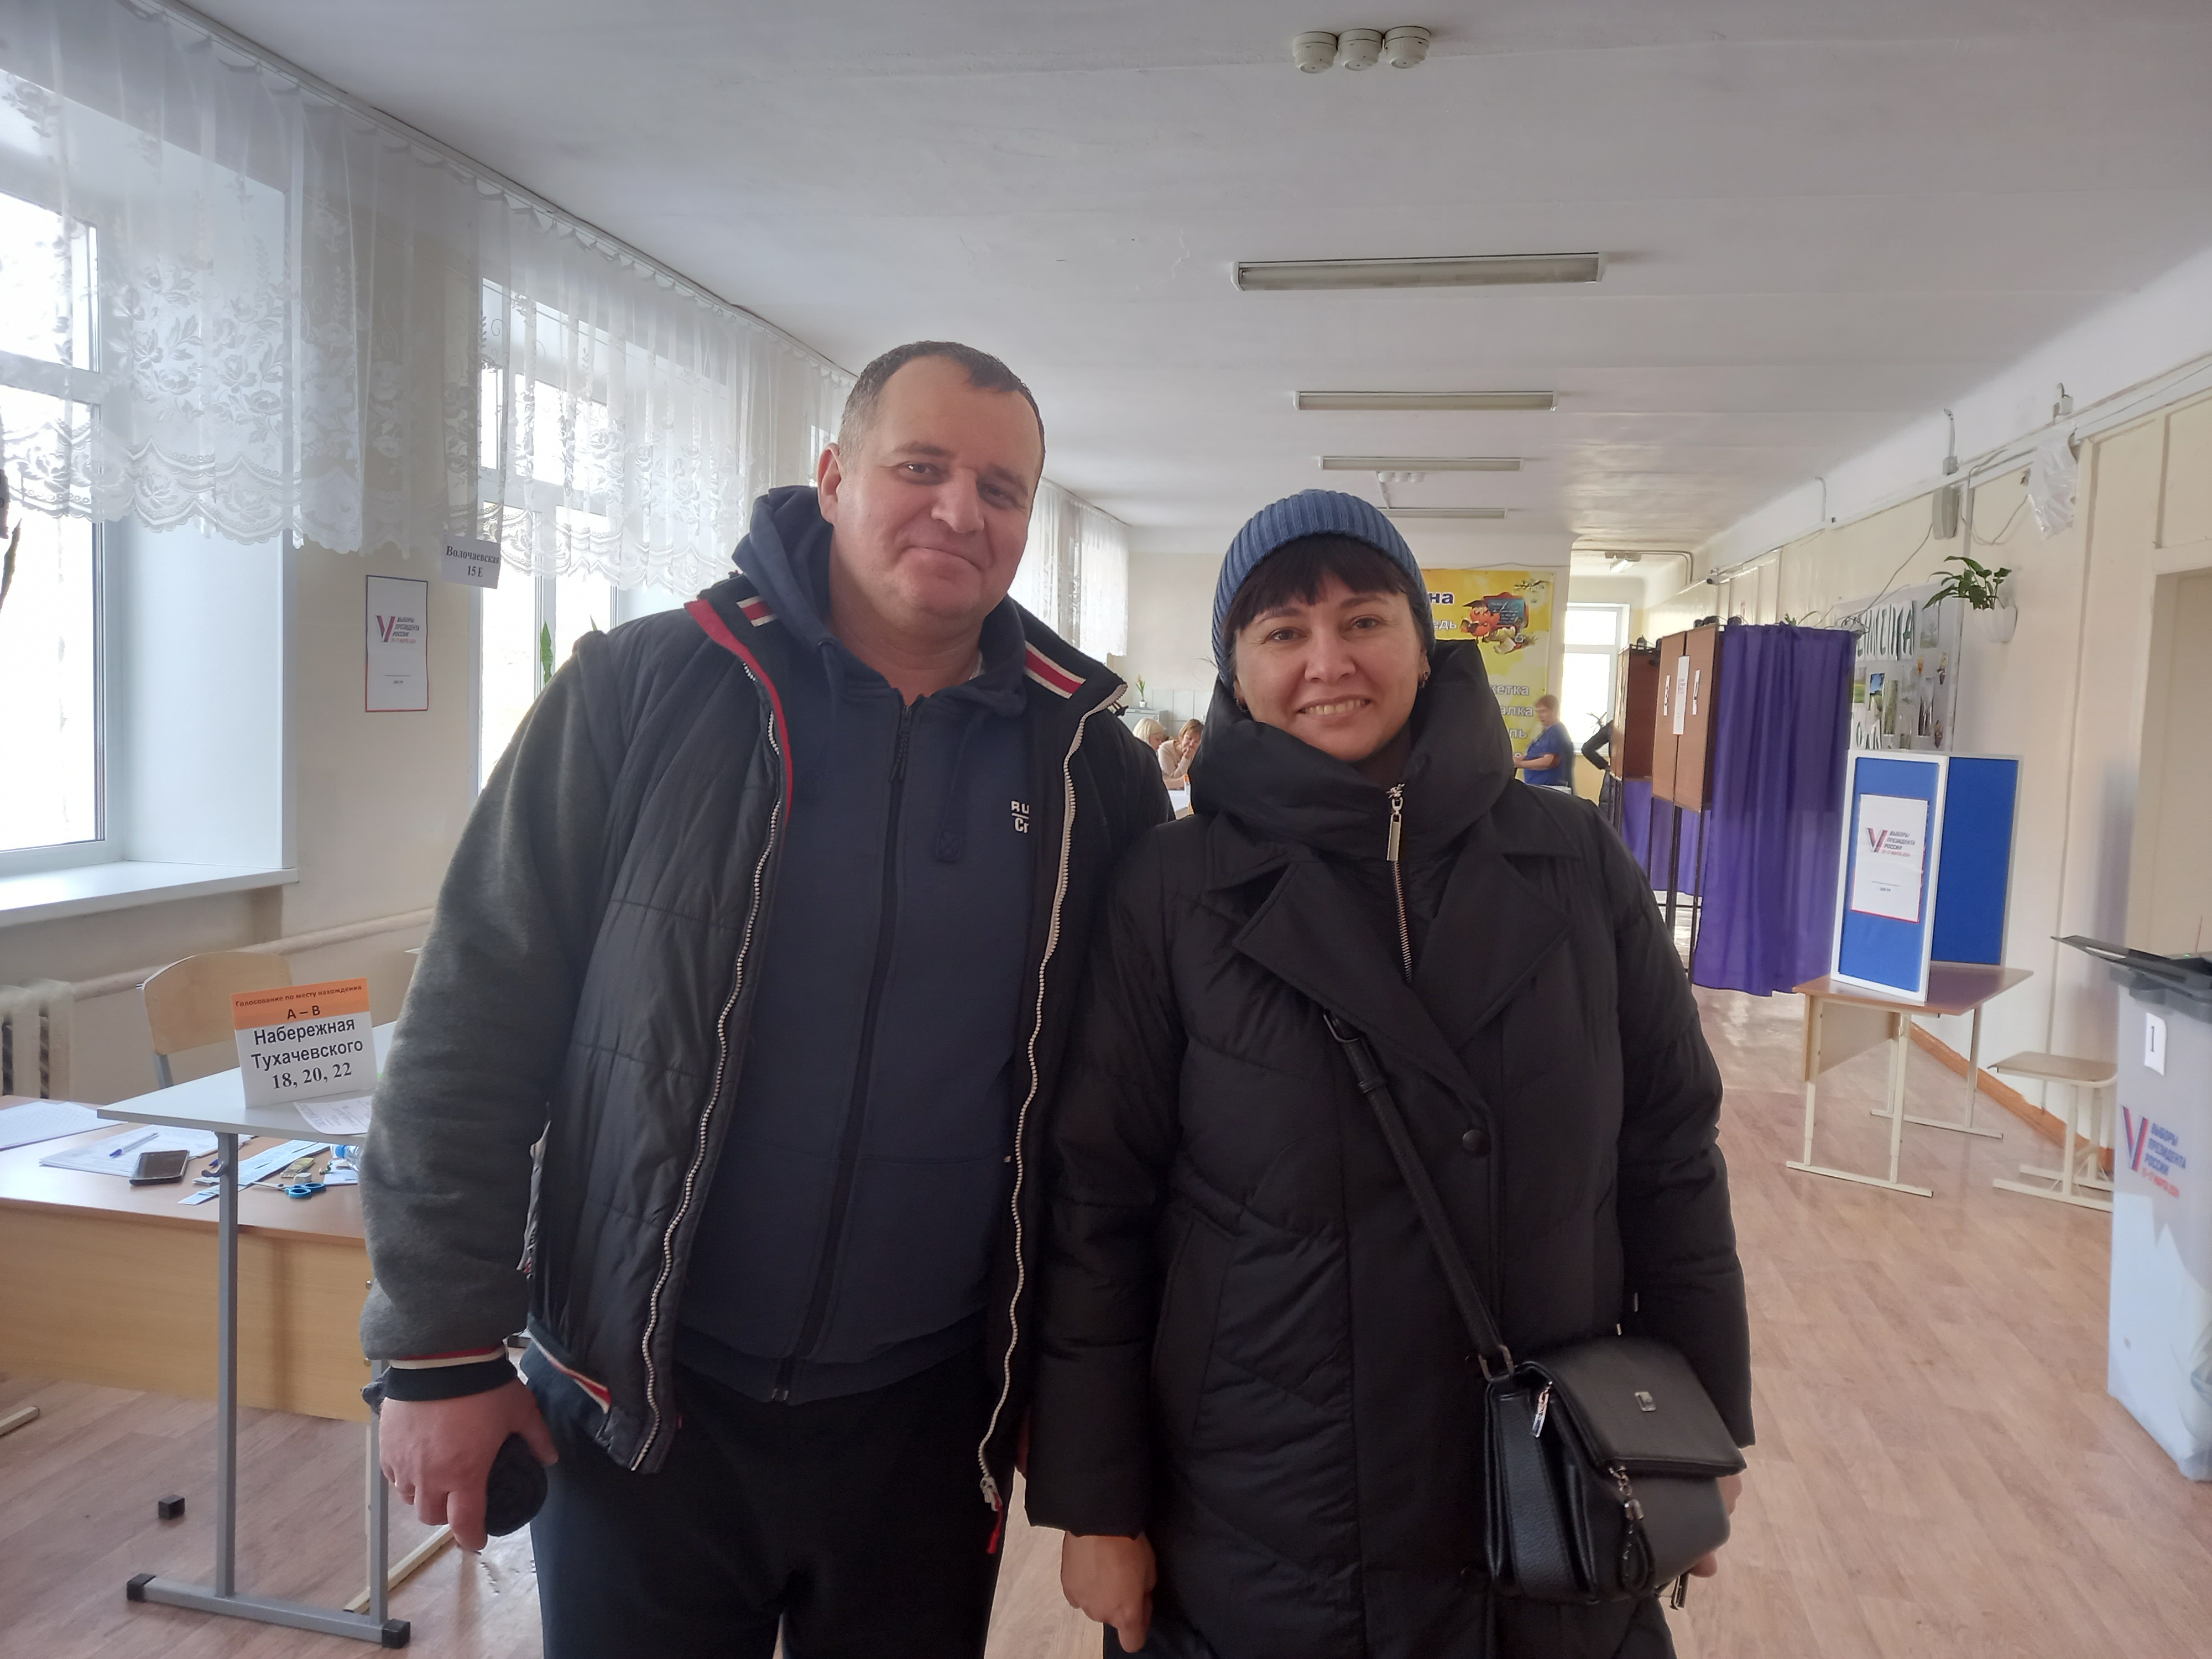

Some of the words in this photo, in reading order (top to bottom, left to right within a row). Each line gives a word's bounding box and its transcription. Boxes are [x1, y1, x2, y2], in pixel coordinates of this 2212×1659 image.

[445, 545, 499, 564] Волочаевская
[468, 565, 476, 576] 15
[478, 567, 483, 577] Е
[236, 996, 283, 1007] Голосование
[318, 985, 362, 995] нахождения
[286, 1009, 296, 1020] А
[312, 1005, 321, 1016] В
[254, 1019, 355, 1045] Набережная
[251, 1040, 363, 1072] Тухачевского
[272, 1072, 298, 1089] 18,
[302, 1067, 328, 1083] 20,
[332, 1062, 352, 1078] 22
